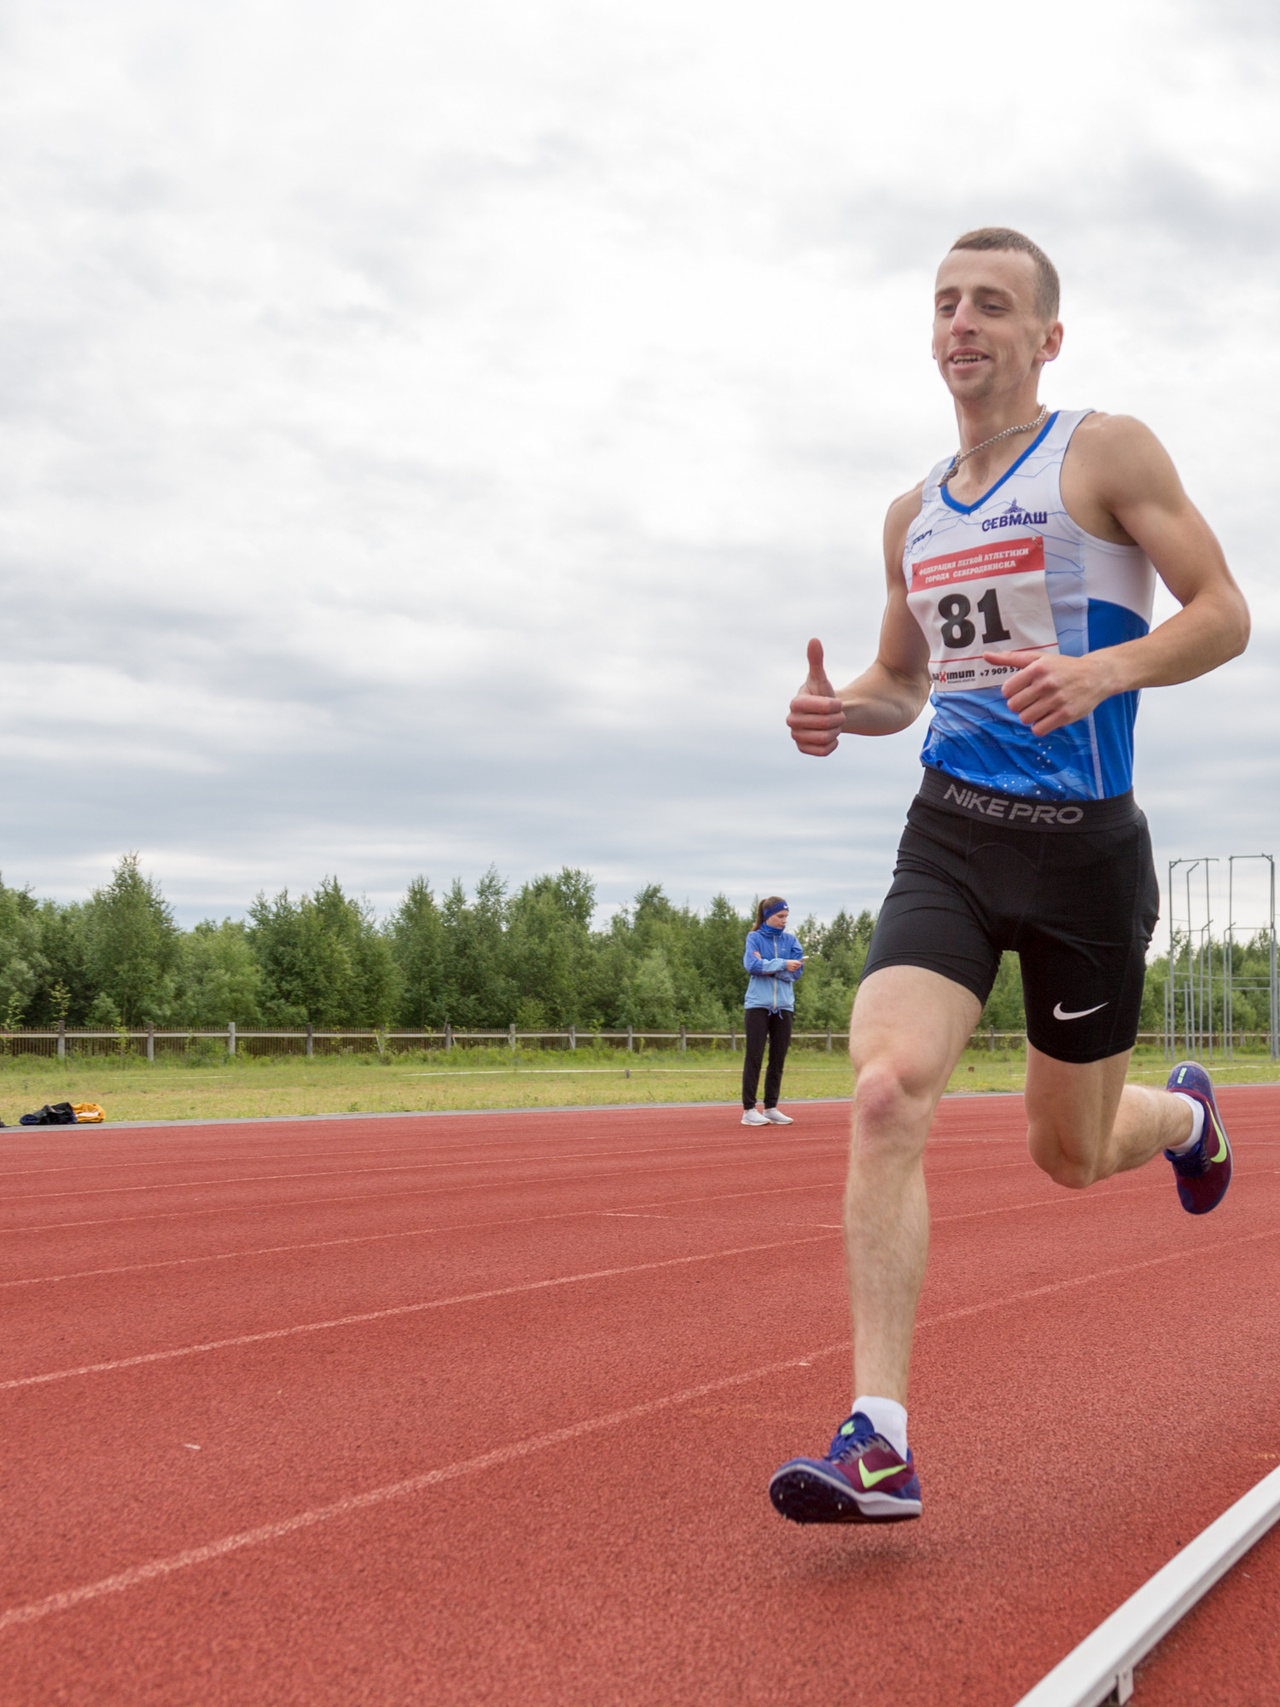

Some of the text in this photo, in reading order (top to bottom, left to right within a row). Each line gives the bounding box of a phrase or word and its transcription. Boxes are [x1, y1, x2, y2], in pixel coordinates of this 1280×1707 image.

[981, 511, 1047, 532] СЕВМАШ
[984, 547, 1029, 561] АТЛЕТИКИ
[953, 560, 1017, 578] СЕВЕРОДВИНСКА
[938, 588, 1011, 648] 81
[991, 666, 1008, 675] 909
[943, 783, 1084, 824] NIKE PRO
